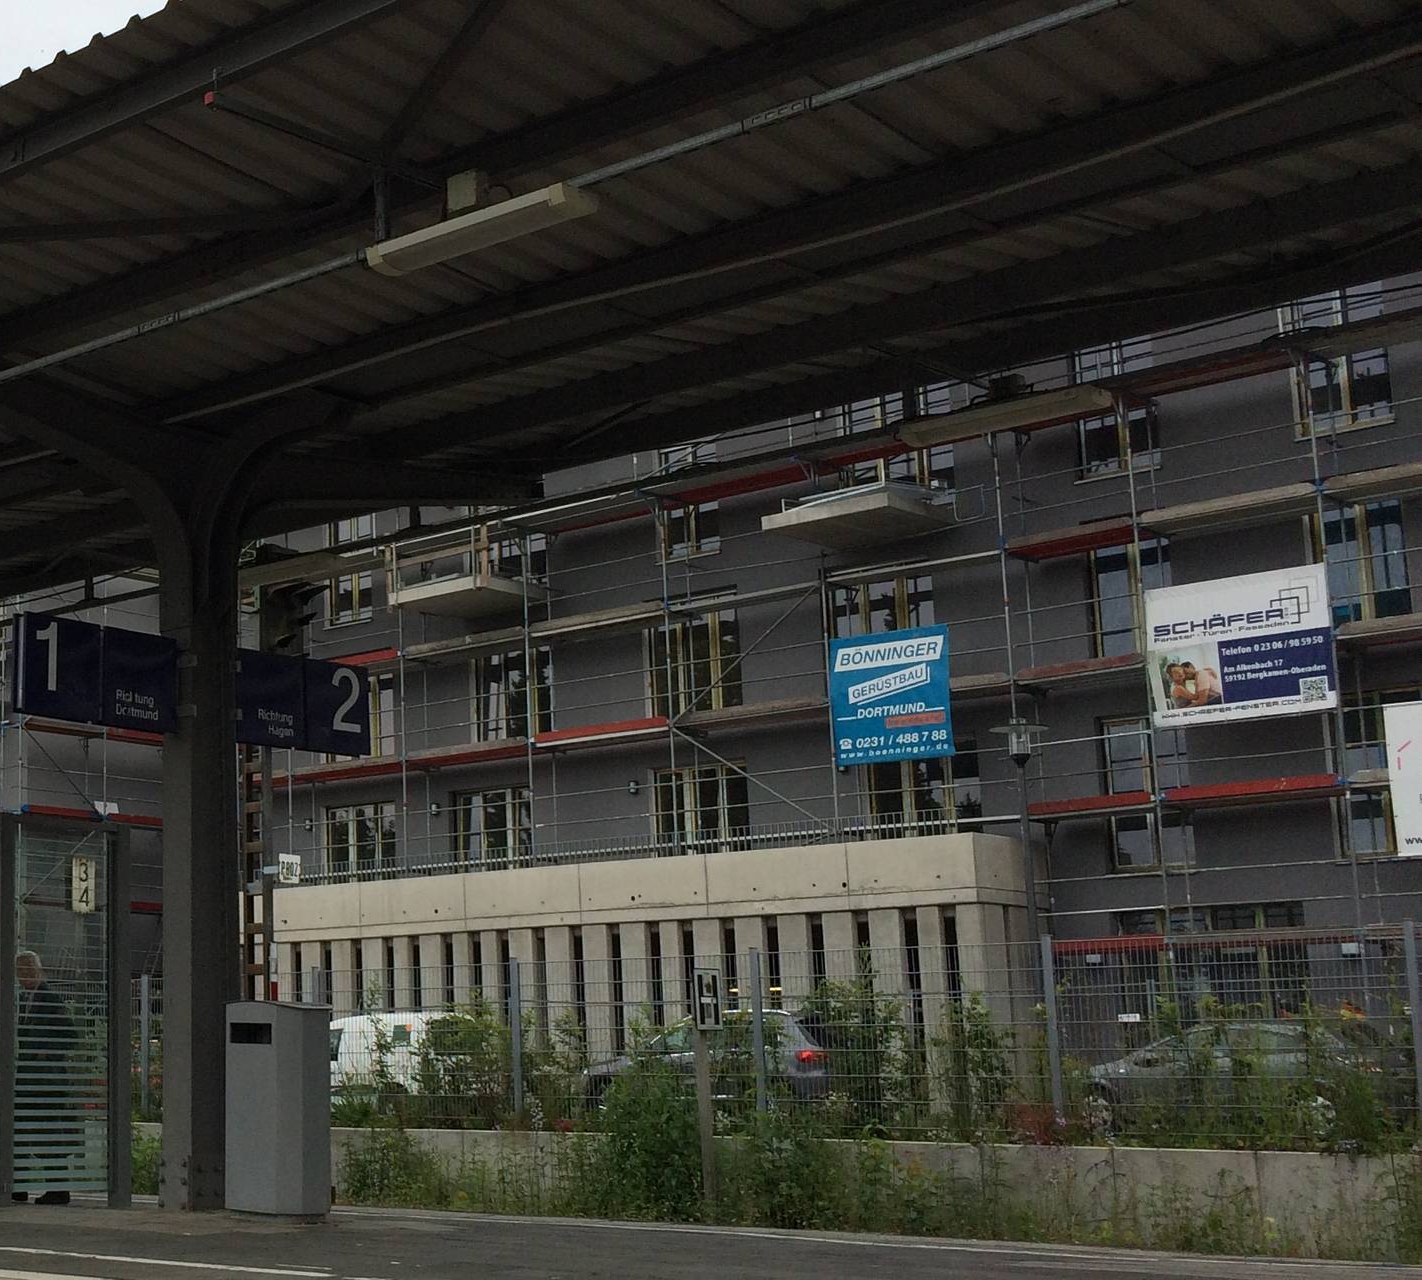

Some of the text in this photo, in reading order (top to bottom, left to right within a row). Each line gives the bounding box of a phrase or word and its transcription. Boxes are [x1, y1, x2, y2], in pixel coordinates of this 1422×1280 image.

[1154, 607, 1284, 637] SCHÄFER
[36, 621, 58, 691] 1
[840, 641, 938, 667] BÖNNINGER
[1221, 645, 1252, 656] Telefon
[331, 667, 362, 733] 2
[258, 708, 294, 726] Richtung
[857, 702, 926, 720] DORTMUND
[268, 723, 294, 738] Hagen
[856, 736, 885, 748] 0231
[931, 729, 947, 741] 88
[79, 862, 89, 882] 3
[79, 886, 90, 907] 4
